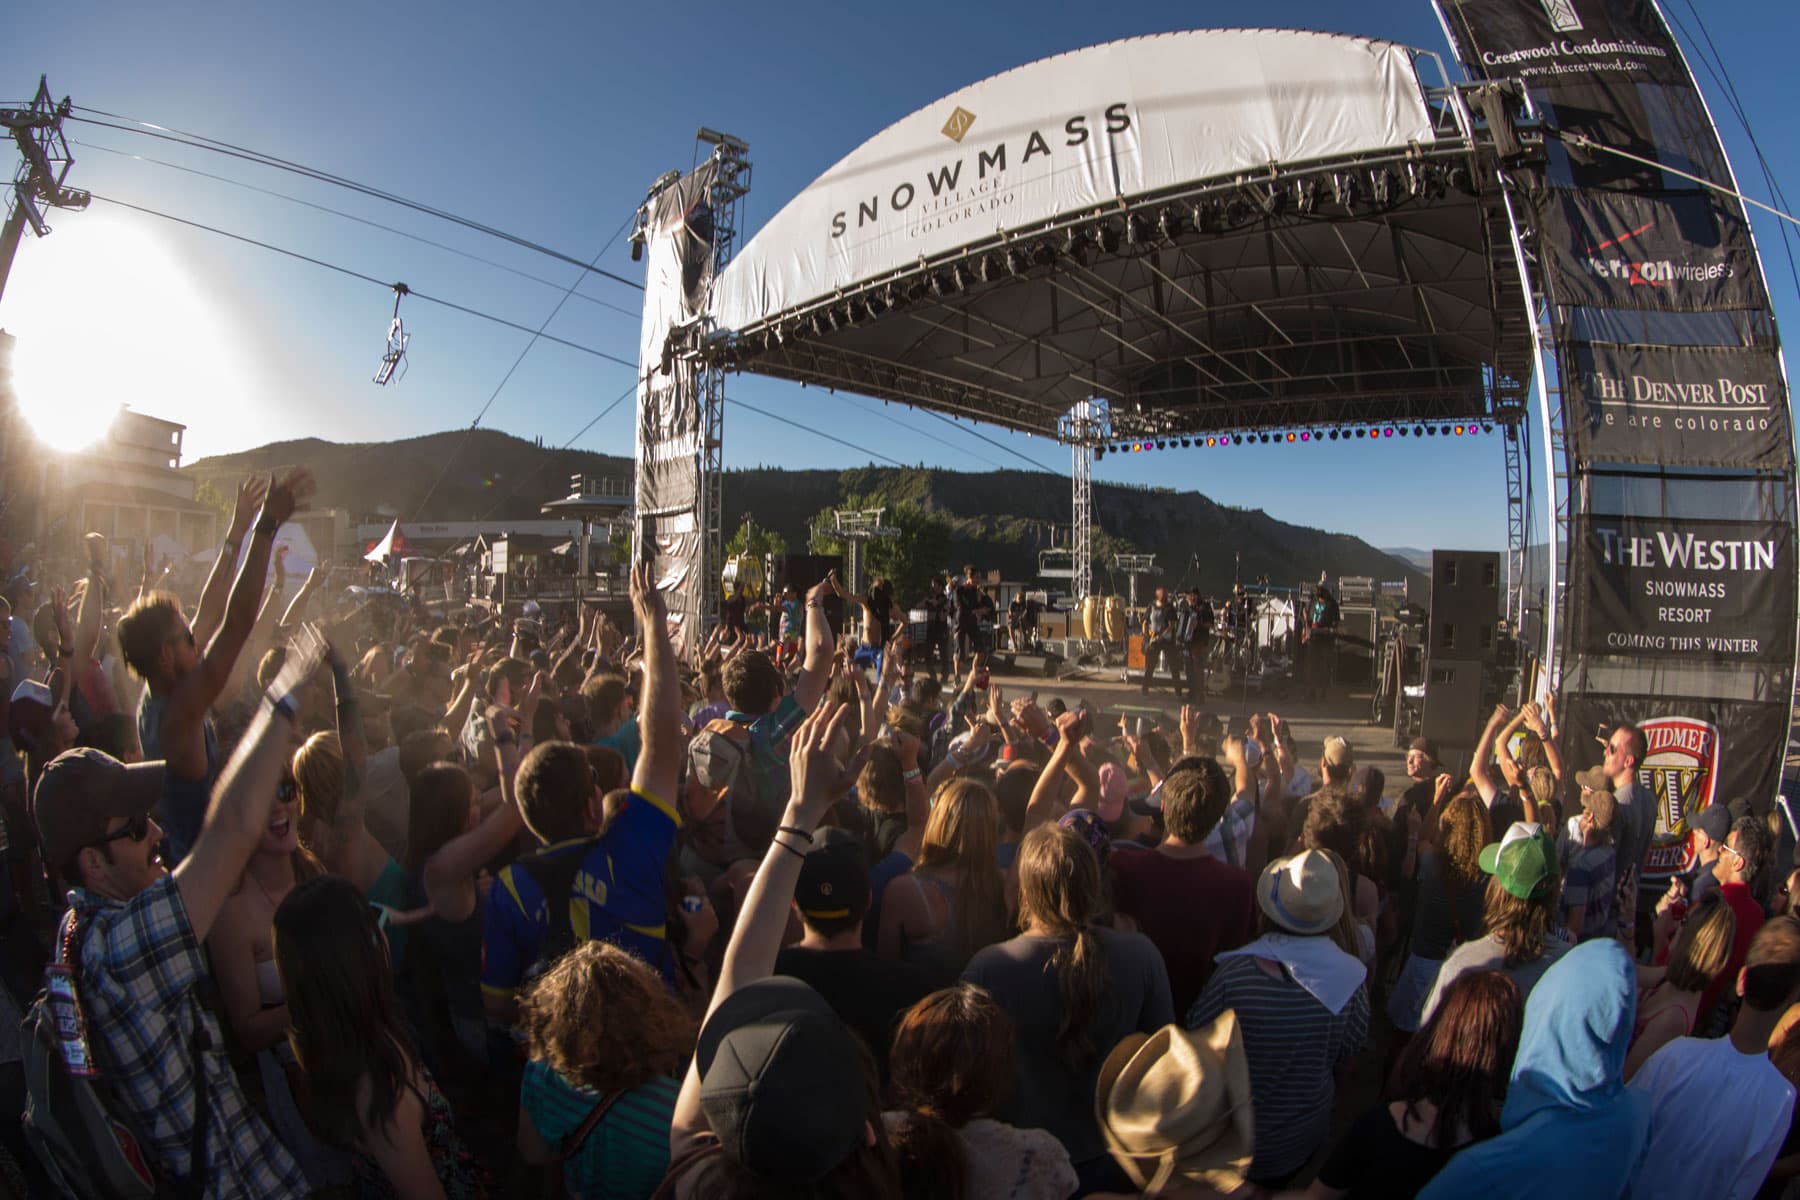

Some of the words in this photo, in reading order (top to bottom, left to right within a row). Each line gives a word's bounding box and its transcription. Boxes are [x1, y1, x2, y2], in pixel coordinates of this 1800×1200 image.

[1483, 42, 1558, 65] Crestwood
[1561, 38, 1667, 58] Condominiums
[831, 103, 1131, 238] SNOWMASS
[922, 176, 1003, 214] VILLAGE
[911, 191, 1015, 238] COLORADO
[1632, 375, 1715, 404] DENVER
[1718, 379, 1767, 404] POST
[1629, 414, 1662, 428] are
[1675, 415, 1768, 431] colorado
[1597, 528, 1655, 568] THE
[1657, 532, 1775, 571] WESTIN
[1646, 580, 1726, 599] SNOWMASS
[1658, 607, 1712, 623] RESORT
[1608, 632, 1665, 650] COMING
[1670, 637, 1701, 650] THIS
[1706, 638, 1759, 653] WINTER
